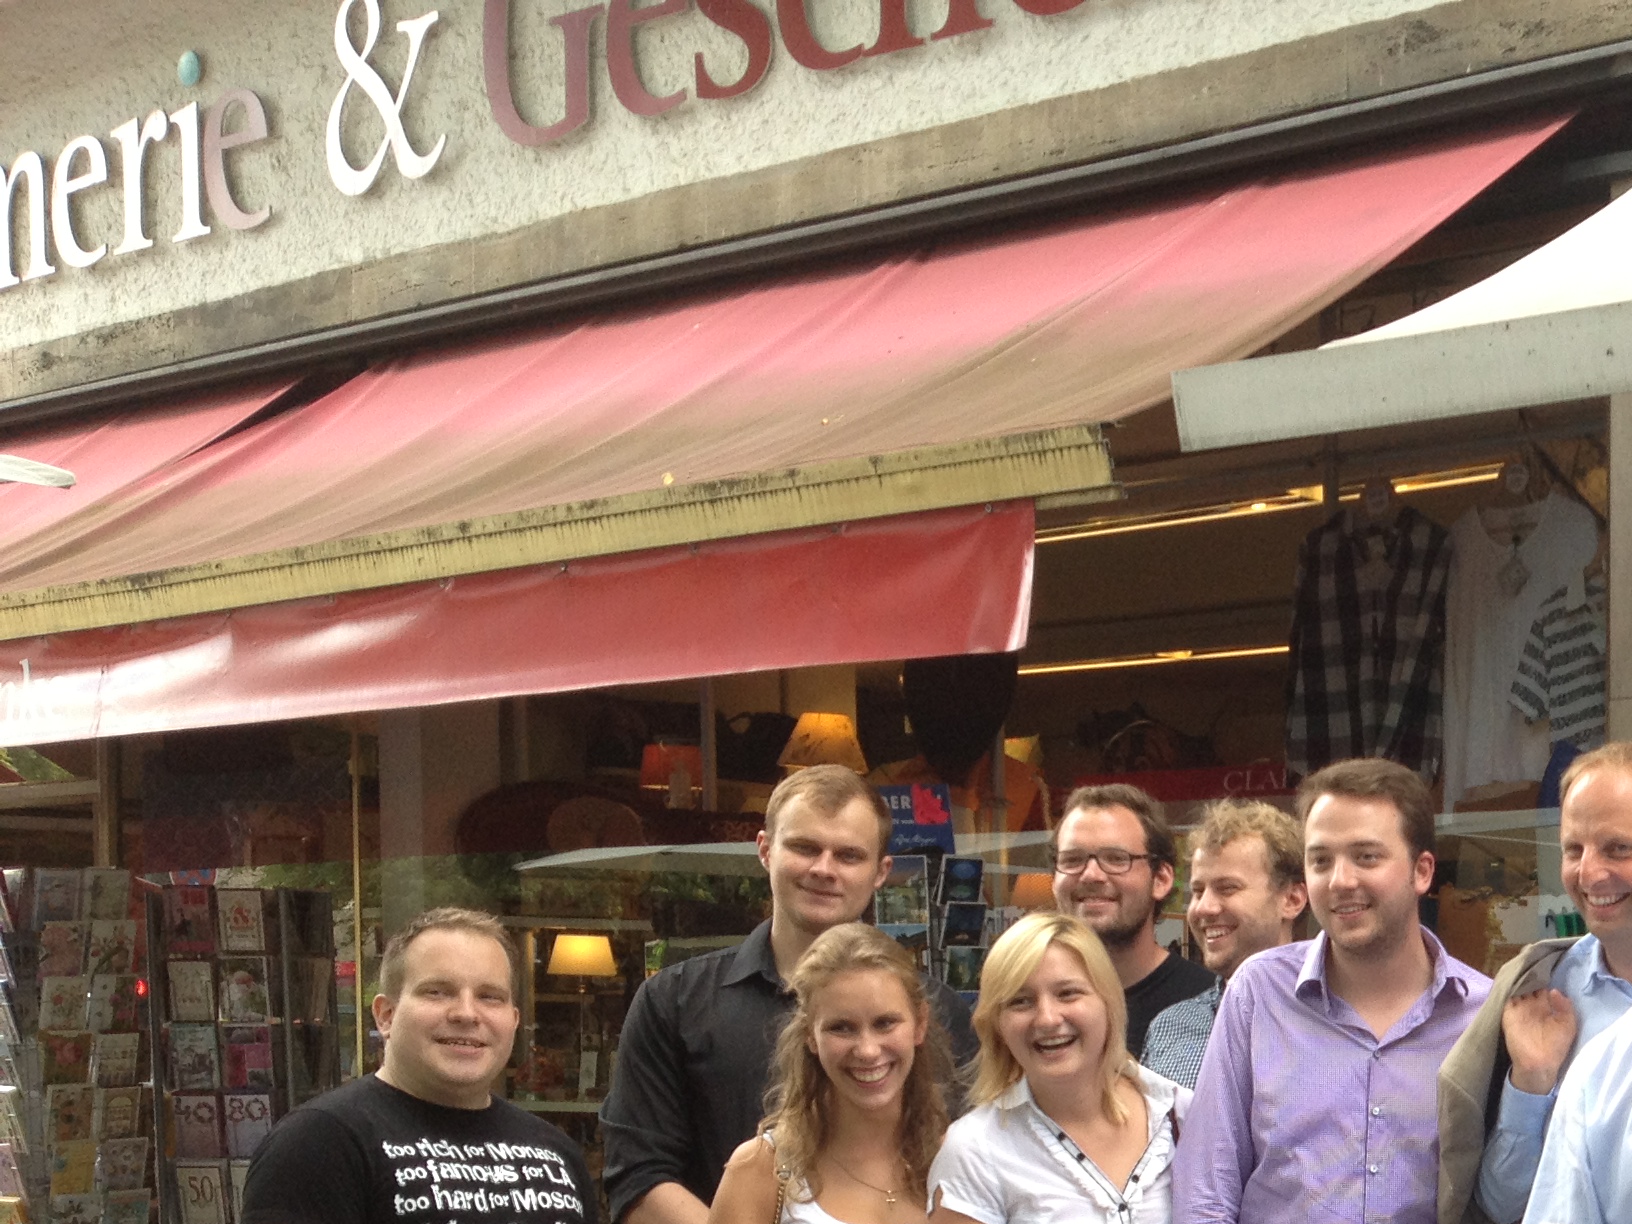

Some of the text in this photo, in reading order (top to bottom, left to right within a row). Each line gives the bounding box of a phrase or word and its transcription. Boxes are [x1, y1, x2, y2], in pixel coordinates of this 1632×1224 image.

[326, 0, 446, 196] &
[382, 1138, 565, 1166] too rich for Monaco
[394, 1159, 577, 1191] too famous for LA
[393, 1193, 430, 1215] too
[430, 1184, 490, 1213] hard
[488, 1192, 509, 1209] for
